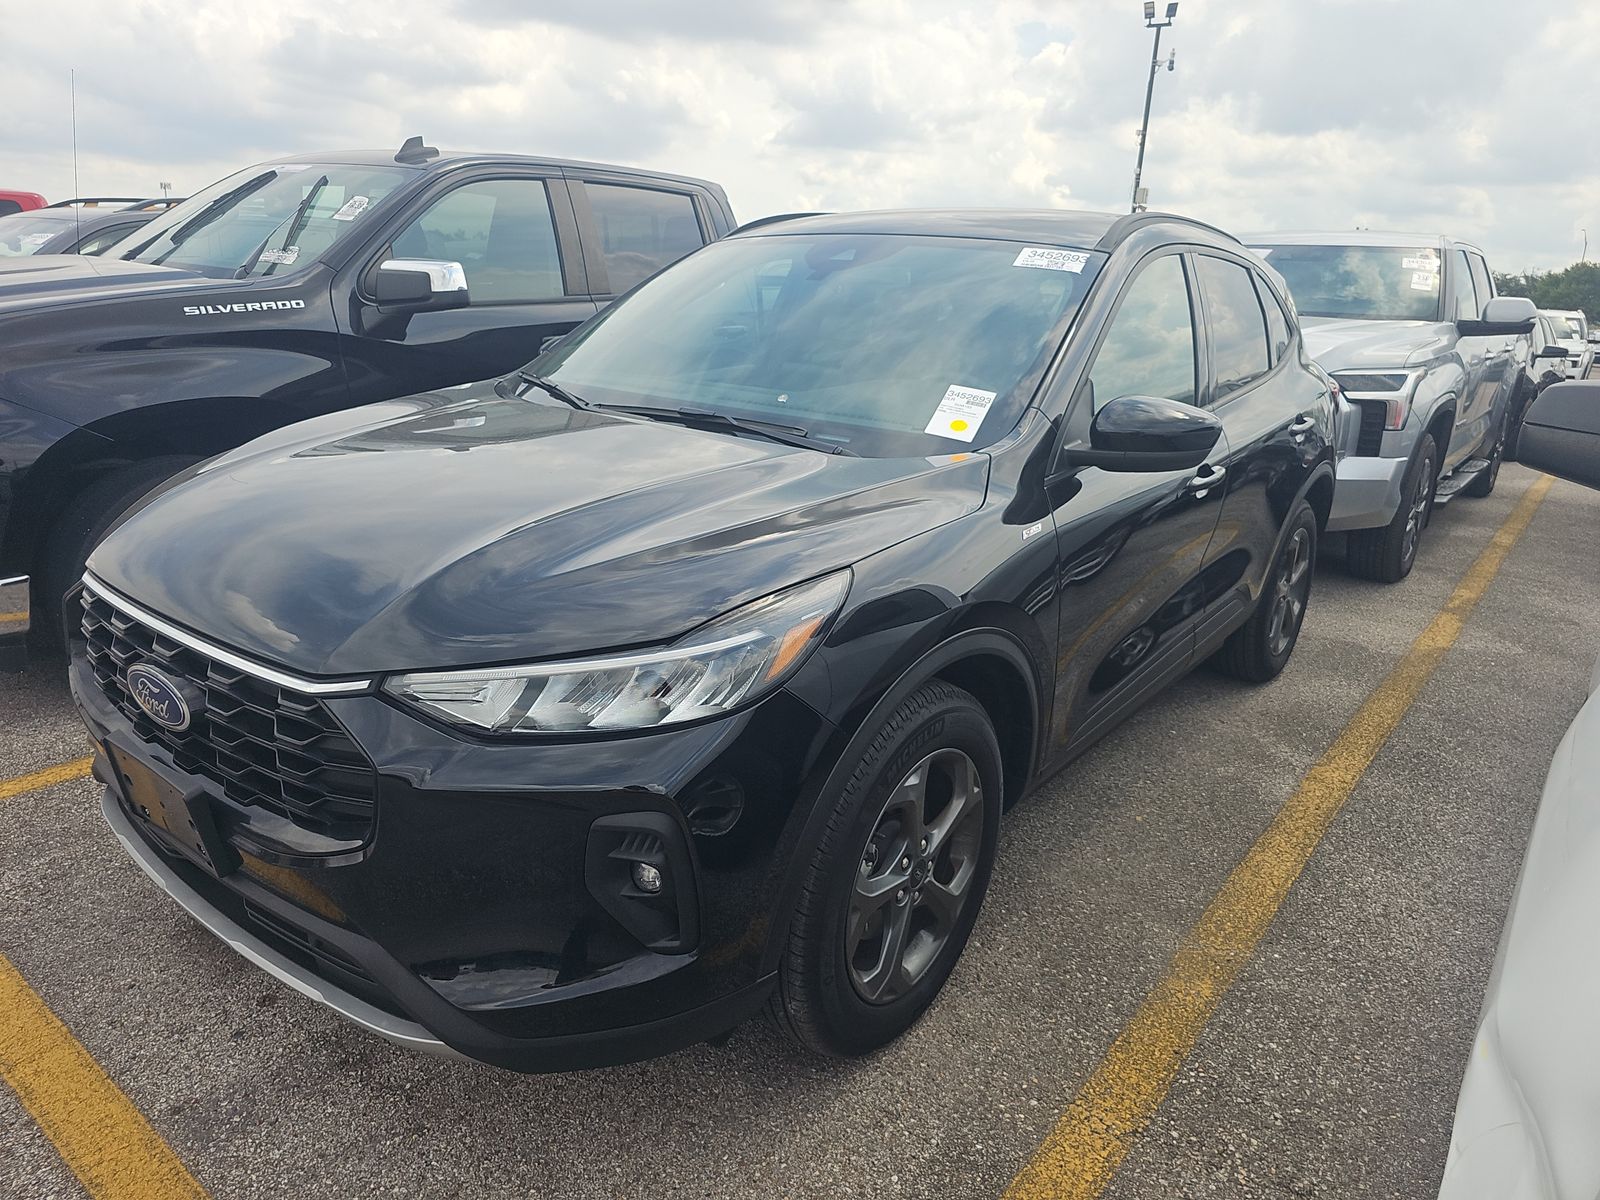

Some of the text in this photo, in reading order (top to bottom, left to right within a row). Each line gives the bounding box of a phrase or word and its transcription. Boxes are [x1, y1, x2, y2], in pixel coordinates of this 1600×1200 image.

[1028, 250, 1088, 263] 3452693
[183, 299, 306, 316] SILVERADO
[947, 390, 992, 404] 3452693
[136, 677, 170, 719] Ford
[887, 720, 944, 781] MICHELIN
